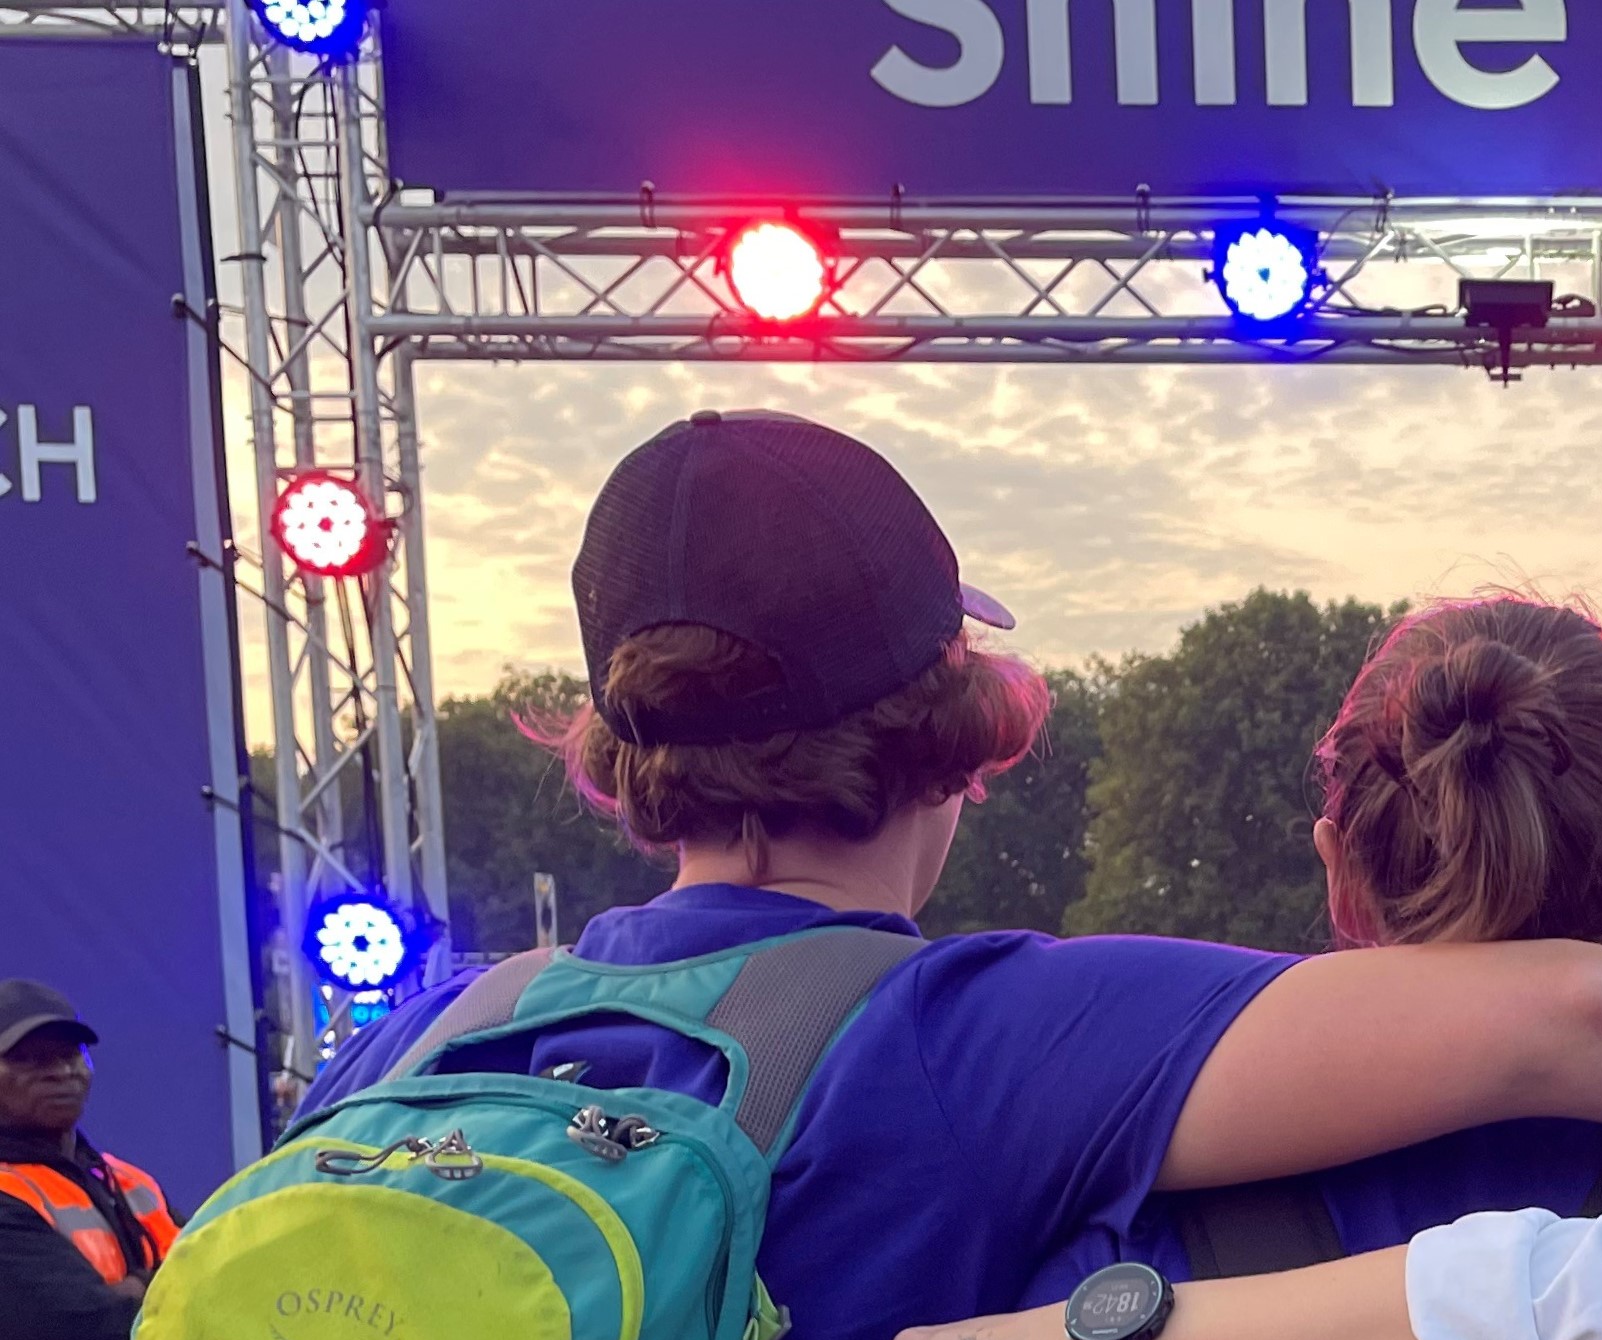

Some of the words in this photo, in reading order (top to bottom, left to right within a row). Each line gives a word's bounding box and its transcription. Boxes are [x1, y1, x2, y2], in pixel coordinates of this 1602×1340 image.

[870, 0, 1568, 107] Shine
[0, 404, 97, 503] H
[276, 1288, 404, 1336] OSPREY
